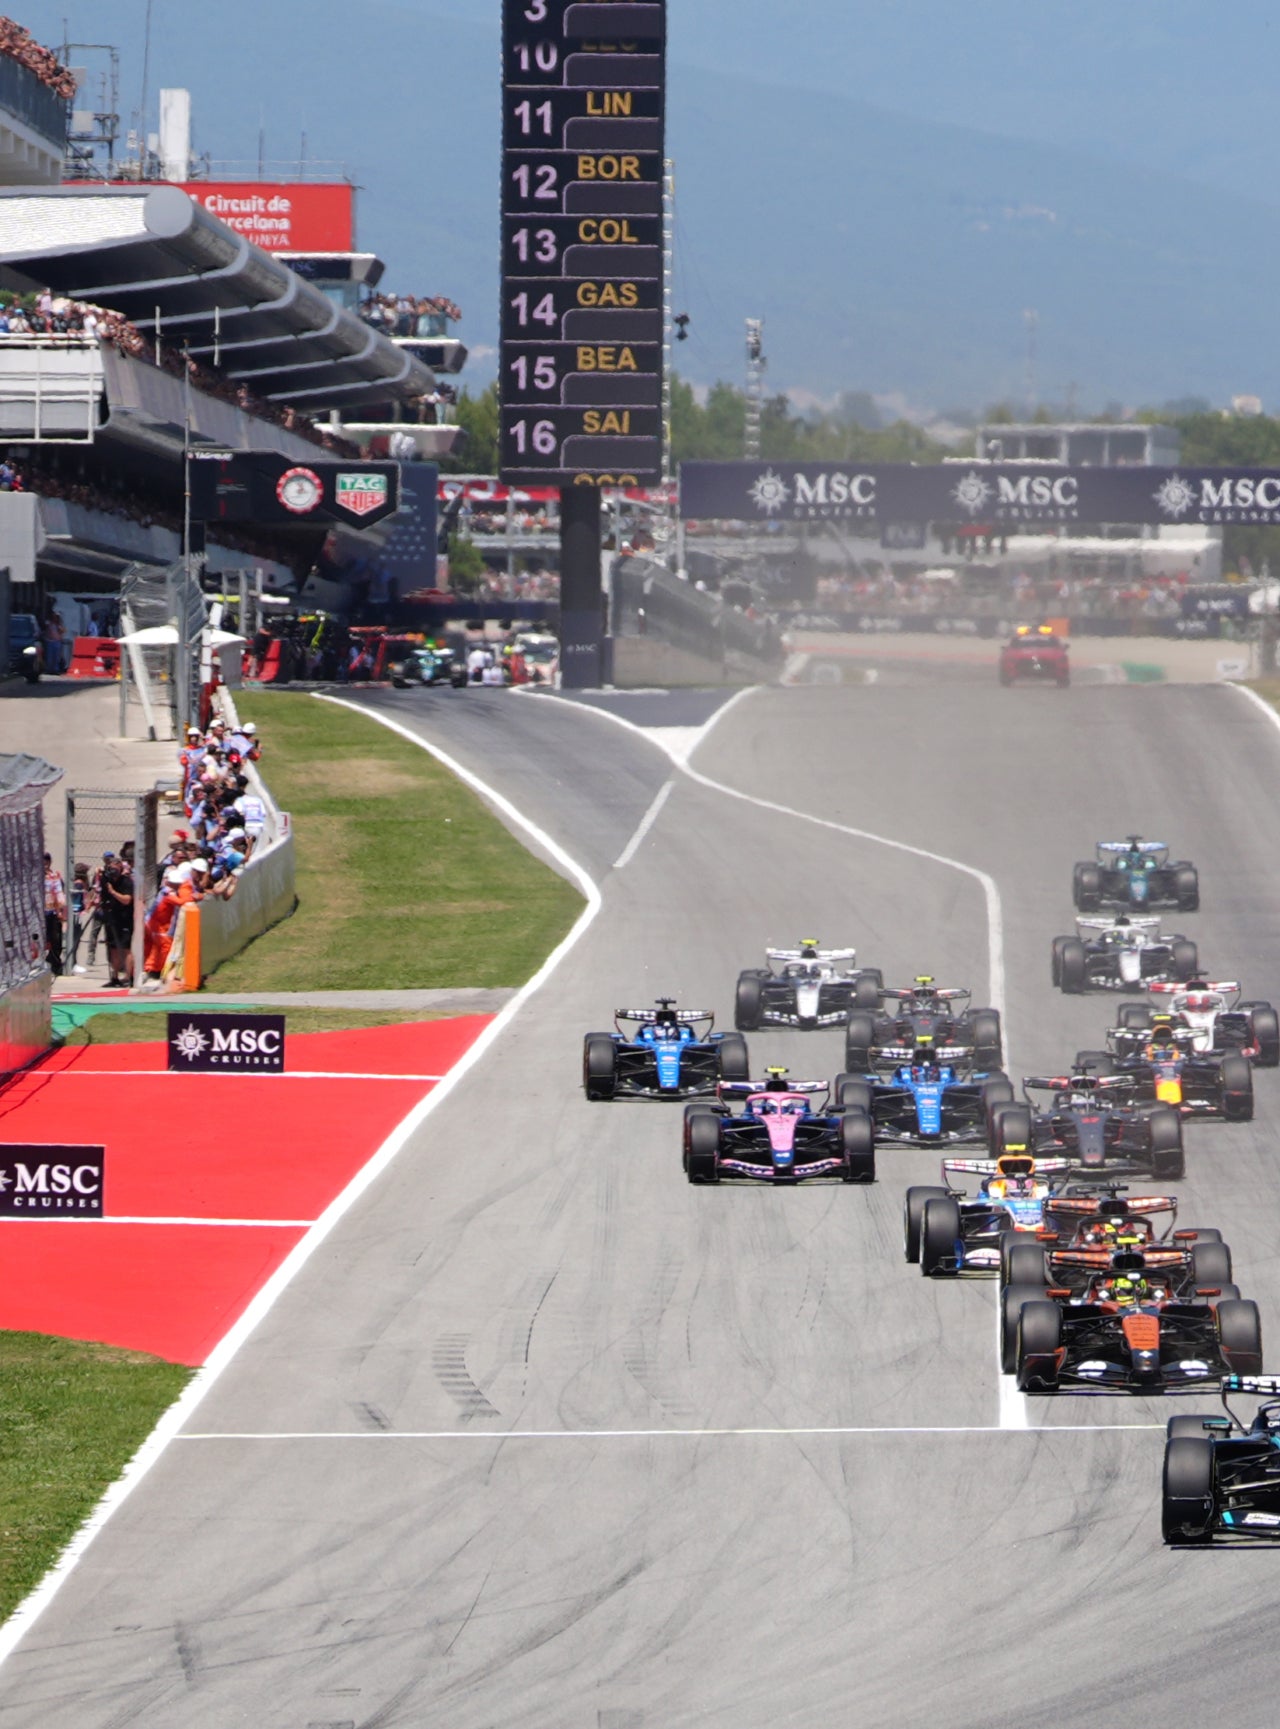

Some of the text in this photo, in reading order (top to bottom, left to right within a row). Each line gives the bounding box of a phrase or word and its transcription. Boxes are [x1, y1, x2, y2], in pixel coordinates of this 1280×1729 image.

[513, 41, 558, 71] 10
[514, 91, 632, 135] 11 LIN
[512, 154, 641, 198] 12 BOR
[204, 194, 290, 212] Circuit de
[511, 219, 639, 262] 13 COL
[511, 281, 639, 326] 14 GAS
[510, 346, 638, 390] 15 BEA
[510, 411, 630, 454] 16 SAI
[343, 477, 382, 491] TAG
[793, 473, 876, 503] MSC
[997, 476, 1078, 505] MSC
[210, 1028, 280, 1054] MSC
[209, 1055, 280, 1065] CRUISES
[14, 1163, 99, 1194] MSC
[13, 1197, 99, 1208] CRUISES
